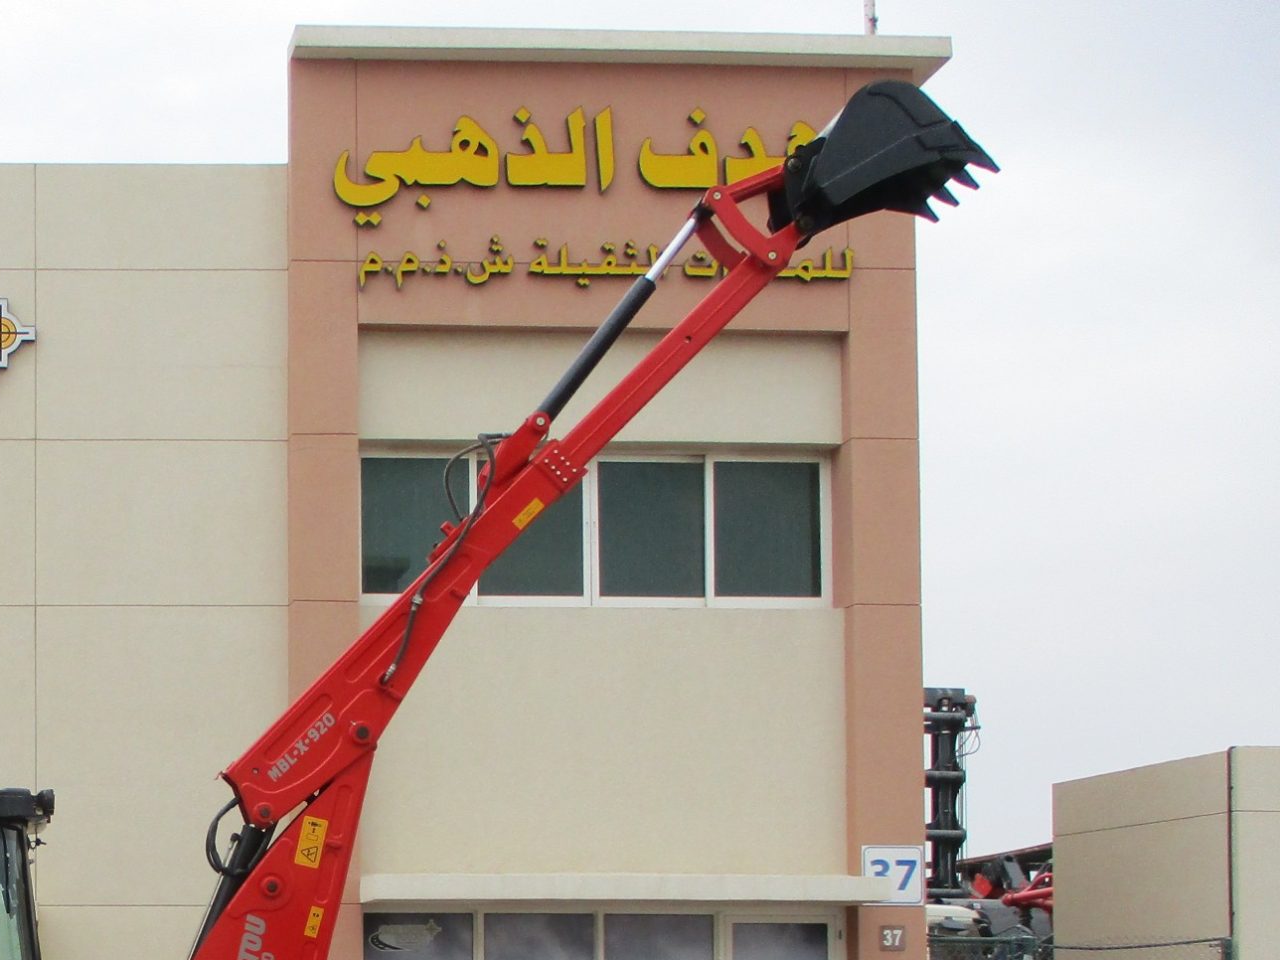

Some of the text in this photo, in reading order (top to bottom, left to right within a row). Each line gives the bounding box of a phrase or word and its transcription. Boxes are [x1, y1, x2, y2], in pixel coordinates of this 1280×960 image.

[333, 105, 616, 228] الذهبي
[267, 712, 336, 783] MBL-X-920
[883, 929, 903, 946] 37
